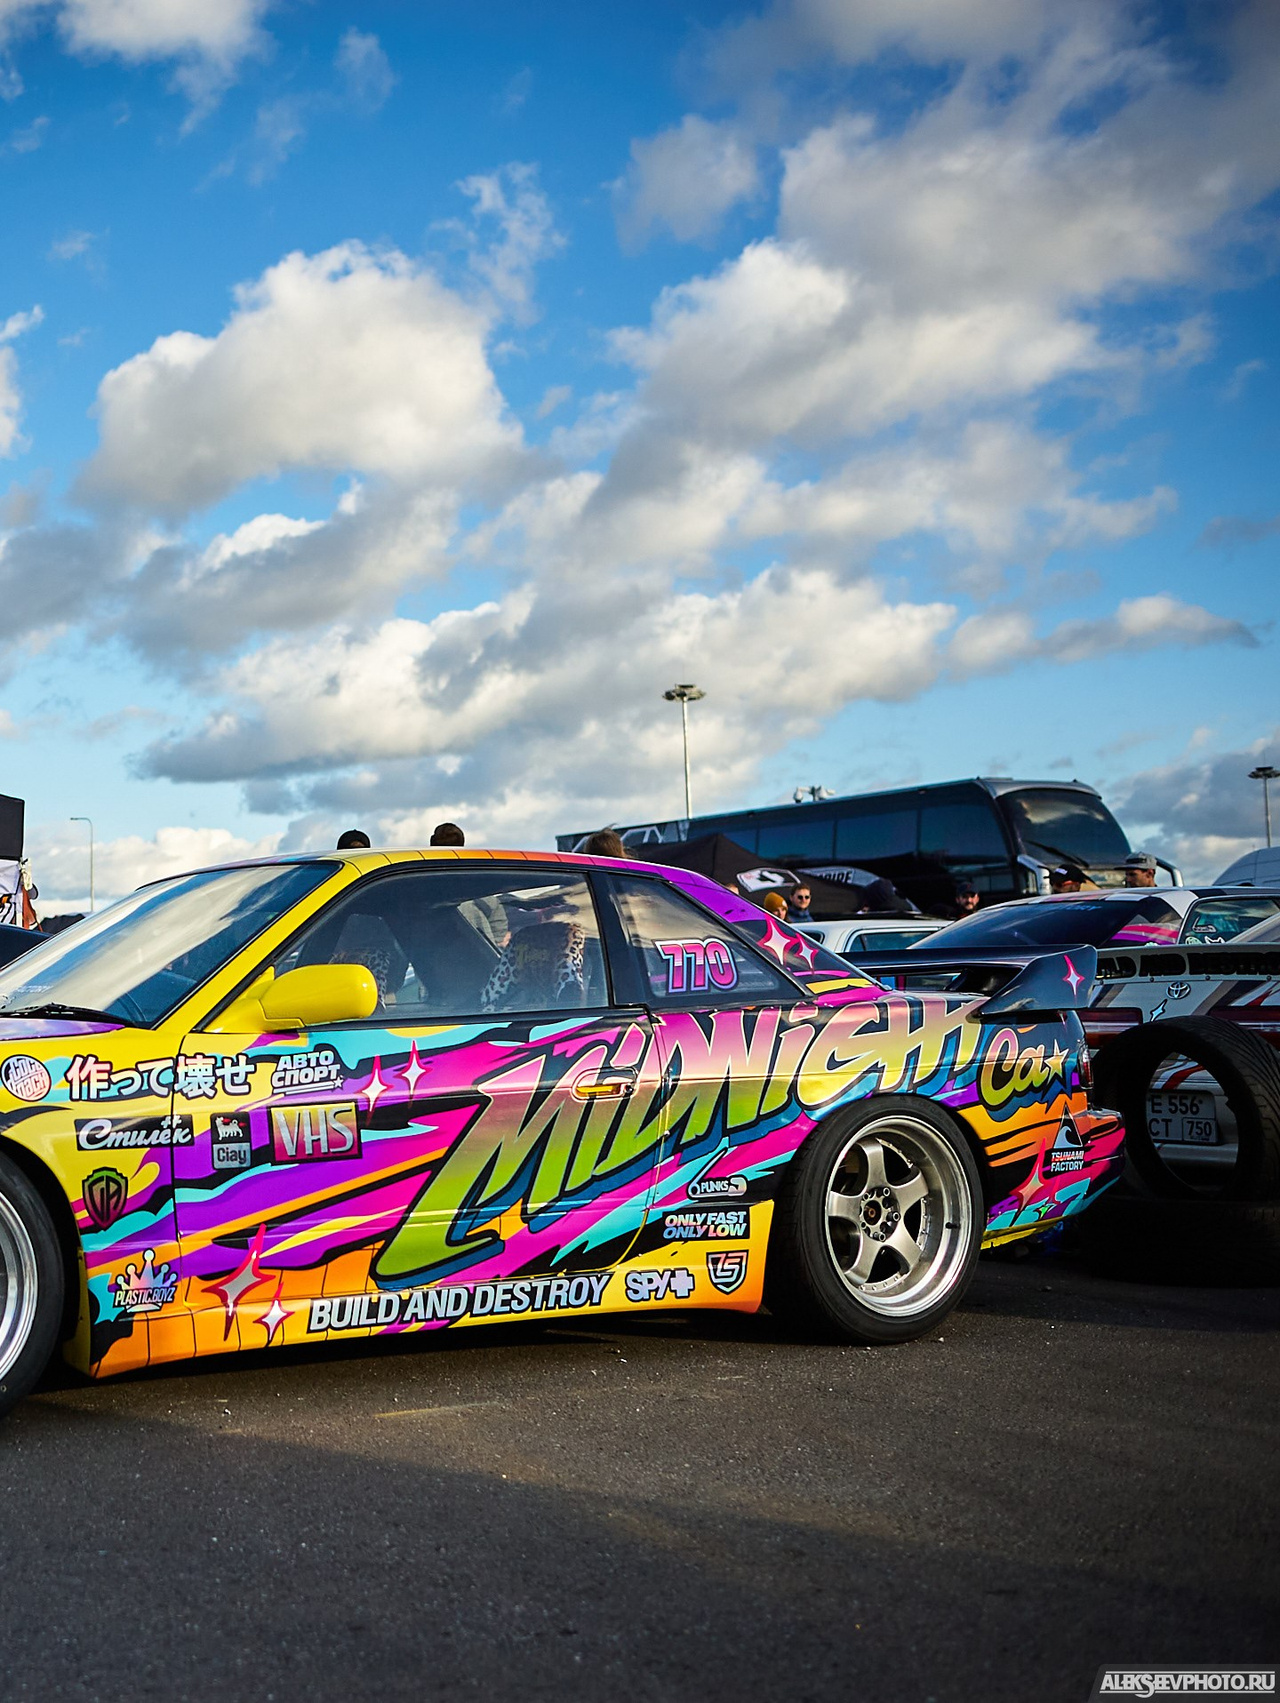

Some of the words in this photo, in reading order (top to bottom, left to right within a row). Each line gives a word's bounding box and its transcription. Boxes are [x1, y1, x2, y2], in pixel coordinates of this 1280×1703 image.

[656, 939, 737, 992] 770
[277, 1050, 335, 1072] АВТО
[66, 1054, 256, 1100] 作って壊せ
[271, 1063, 341, 1088] СПОРТ
[1151, 1095, 1162, 1114] E
[1168, 1096, 1200, 1115] 556
[274, 1107, 355, 1157] VHS
[1187, 1120, 1212, 1137] 750
[1050, 1160, 1084, 1173] FACTORY
[1051, 1150, 1085, 1162] TSUNAMI
[664, 1212, 707, 1227] ONLY
[707, 1210, 747, 1225] FAST
[663, 1225, 708, 1239] ONLY
[708, 1223, 747, 1238] LOW
[309, 1293, 402, 1331] BUILD
[405, 1286, 473, 1321] AND
[473, 1274, 608, 1315] DESTROY
